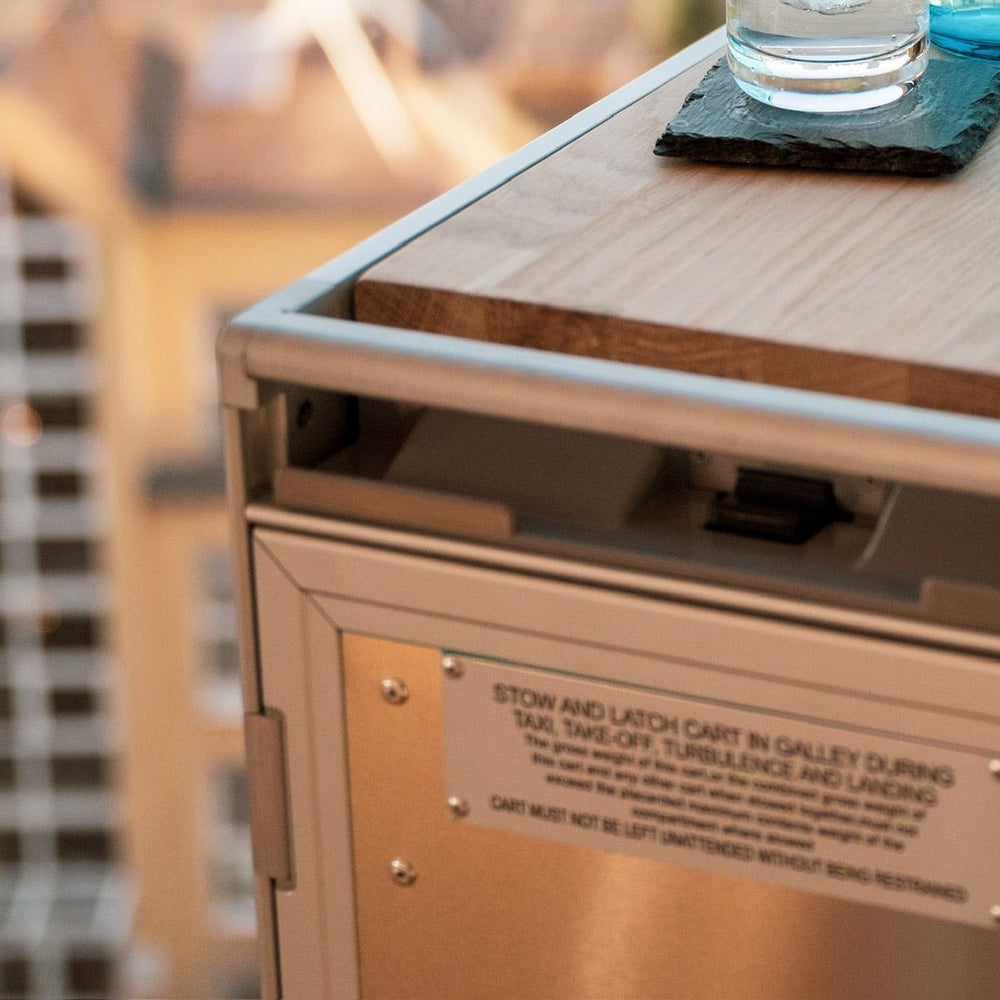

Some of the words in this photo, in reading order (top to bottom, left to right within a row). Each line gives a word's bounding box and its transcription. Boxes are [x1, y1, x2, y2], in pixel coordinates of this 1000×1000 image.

[493, 683, 556, 710] STOW
[559, 698, 605, 720] AND
[609, 707, 678, 733] LATCH
[683, 719, 740, 744] CART
[748, 731, 769, 751] IN
[774, 736, 859, 766] GALLEY
[866, 753, 954, 786] DURING
[513, 709, 557, 735] TAXI,
[663, 738, 791, 778] TURBULENCE
[799, 766, 841, 788] AND
[846, 776, 936, 805] LANDING
[524, 735, 547, 748] The
[552, 741, 587, 757] gross
[592, 749, 634, 765] weight
[638, 757, 651, 769] of
[727, 773, 748, 787] the
[822, 793, 859, 808] gross
[864, 801, 908, 816] weight
[912, 809, 926, 821] of
[558, 759, 582, 772] cart
[587, 765, 610, 778] and
[614, 770, 637, 784] any
[643, 775, 675, 790] other
[680, 783, 704, 795] cart
[708, 788, 742, 803] when
[748, 795, 795, 813] stowed
[897, 825, 918, 837] not
[596, 782, 615, 796] the
[818, 826, 861, 842] weight
[866, 835, 880, 846] of
[883, 837, 904, 851] the
[490, 795, 525, 814] CART
[529, 803, 566, 823] MUST
[570, 811, 597, 829] NOT
[602, 816, 618, 836] BE
[623, 822, 655, 839] LEFT
[661, 831, 754, 861] UNATTENDED
[757, 849, 822, 872] WITHOUT
[826, 861, 870, 884] BEING
[874, 871, 967, 902] RESTRAINED
